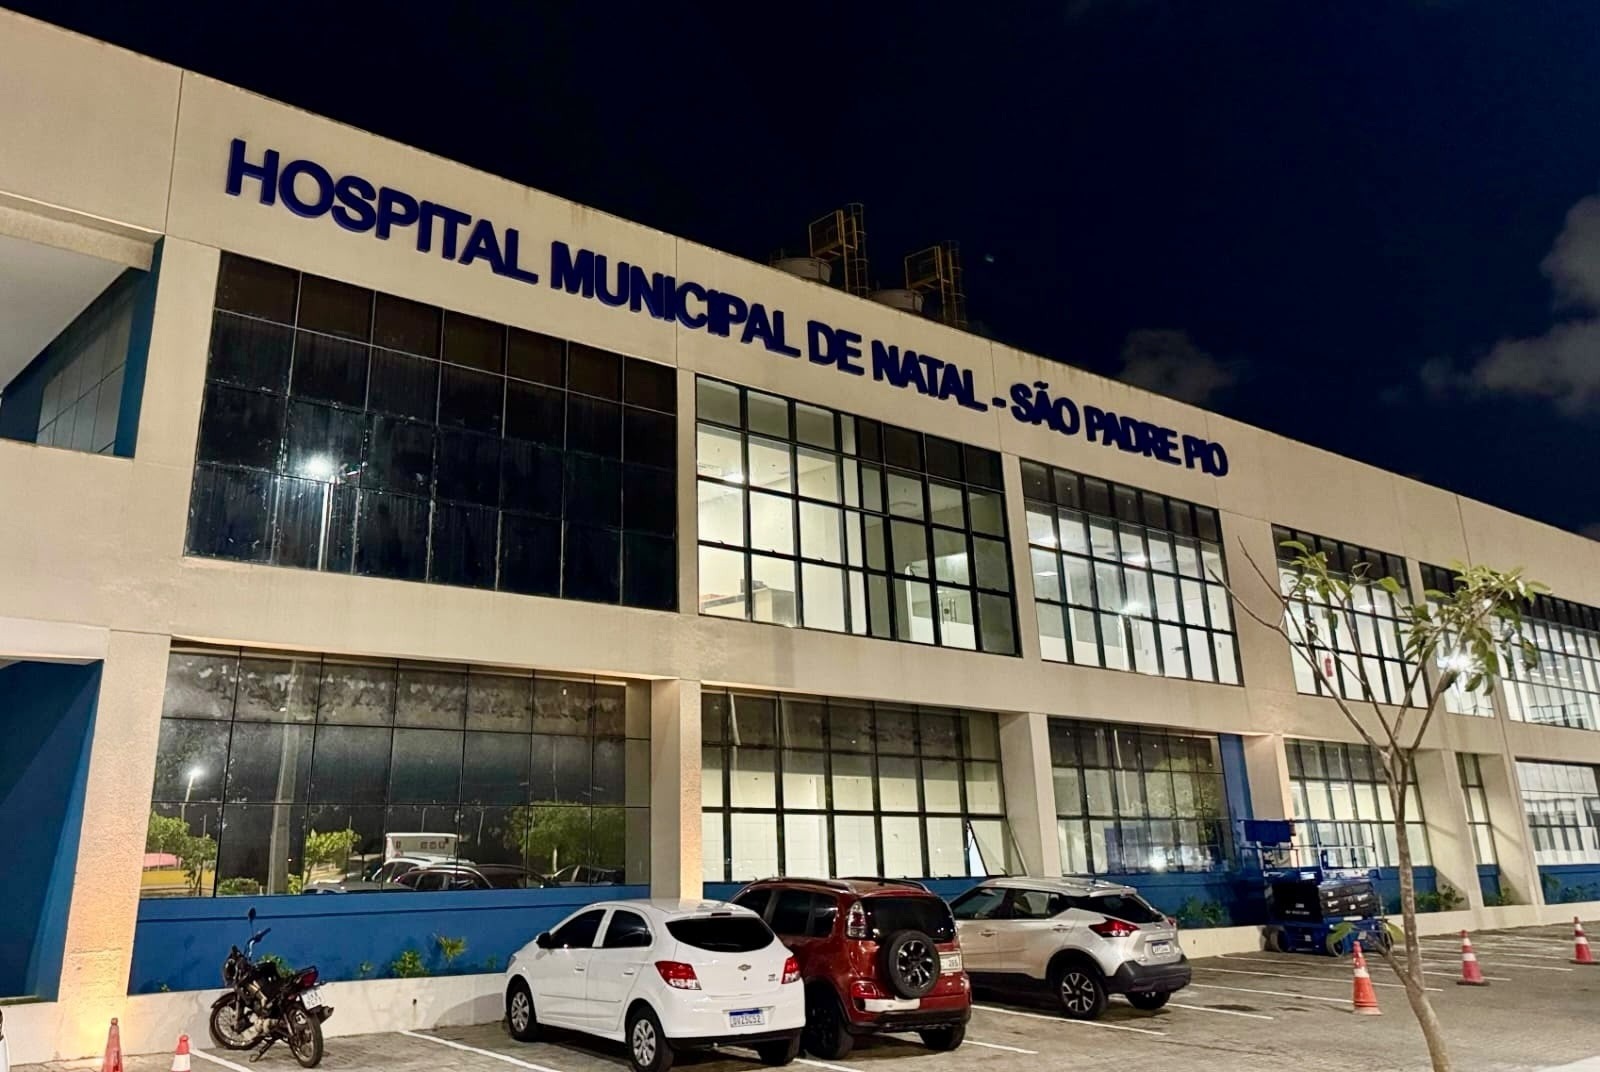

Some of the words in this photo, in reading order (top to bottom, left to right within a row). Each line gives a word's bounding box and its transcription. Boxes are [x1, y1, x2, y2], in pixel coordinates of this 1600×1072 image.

[227, 139, 537, 284] HOSPITAL
[551, 242, 800, 356] MUNICIPAL
[808, 321, 864, 374] DE
[872, 340, 987, 411] NATAL
[991, 397, 1006, 408] -
[1010, 381, 1080, 435] SÃO
[1085, 407, 1179, 464] PADRE
[1183, 435, 1228, 476] PIO
